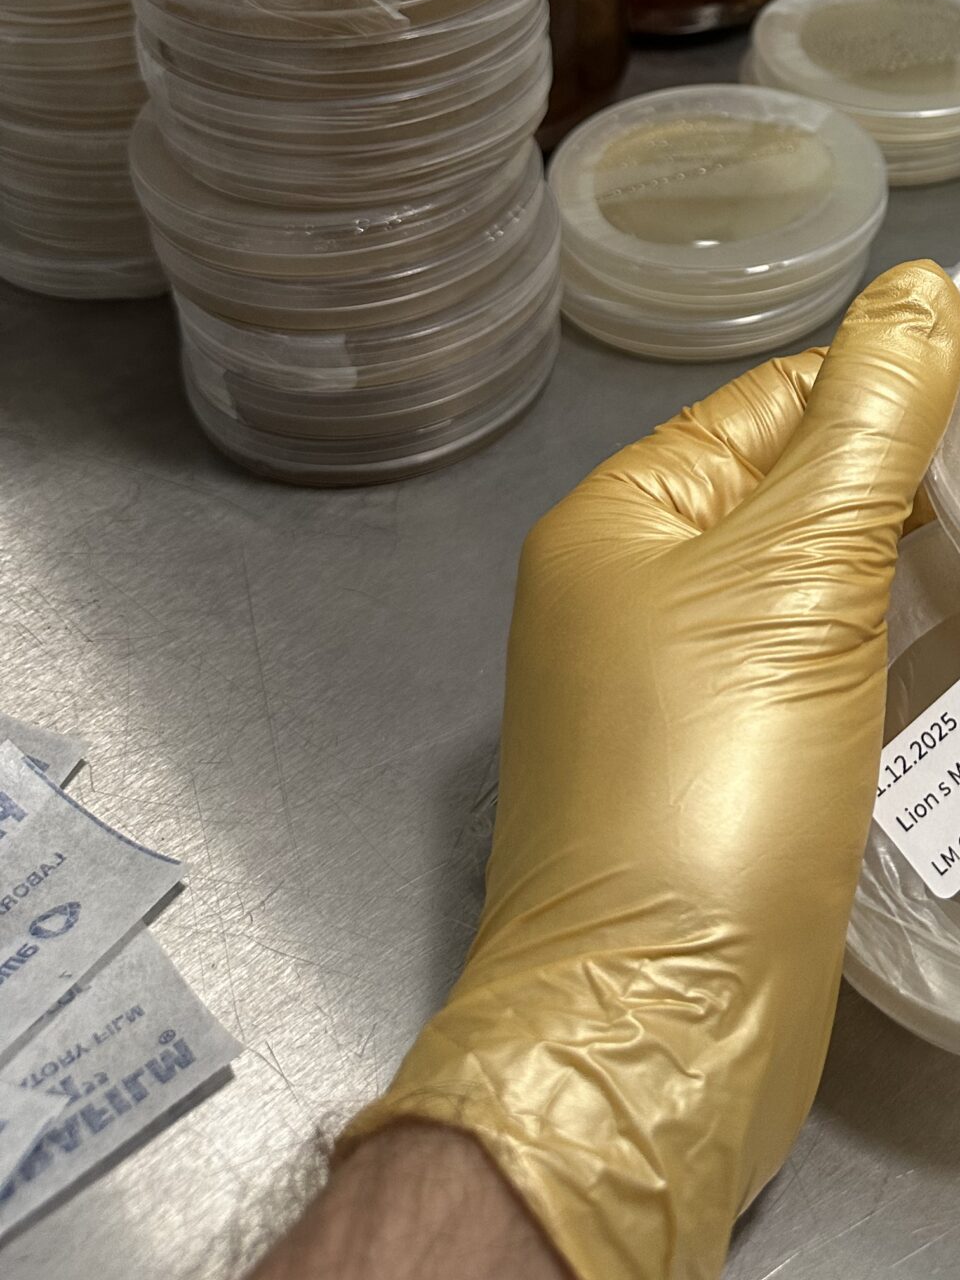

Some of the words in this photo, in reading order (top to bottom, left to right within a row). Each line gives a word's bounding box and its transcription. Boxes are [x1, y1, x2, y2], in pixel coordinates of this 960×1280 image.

[896, 793, 939, 832] Lion
[938, 782, 951, 796] s
[931, 846, 960, 876] LM
